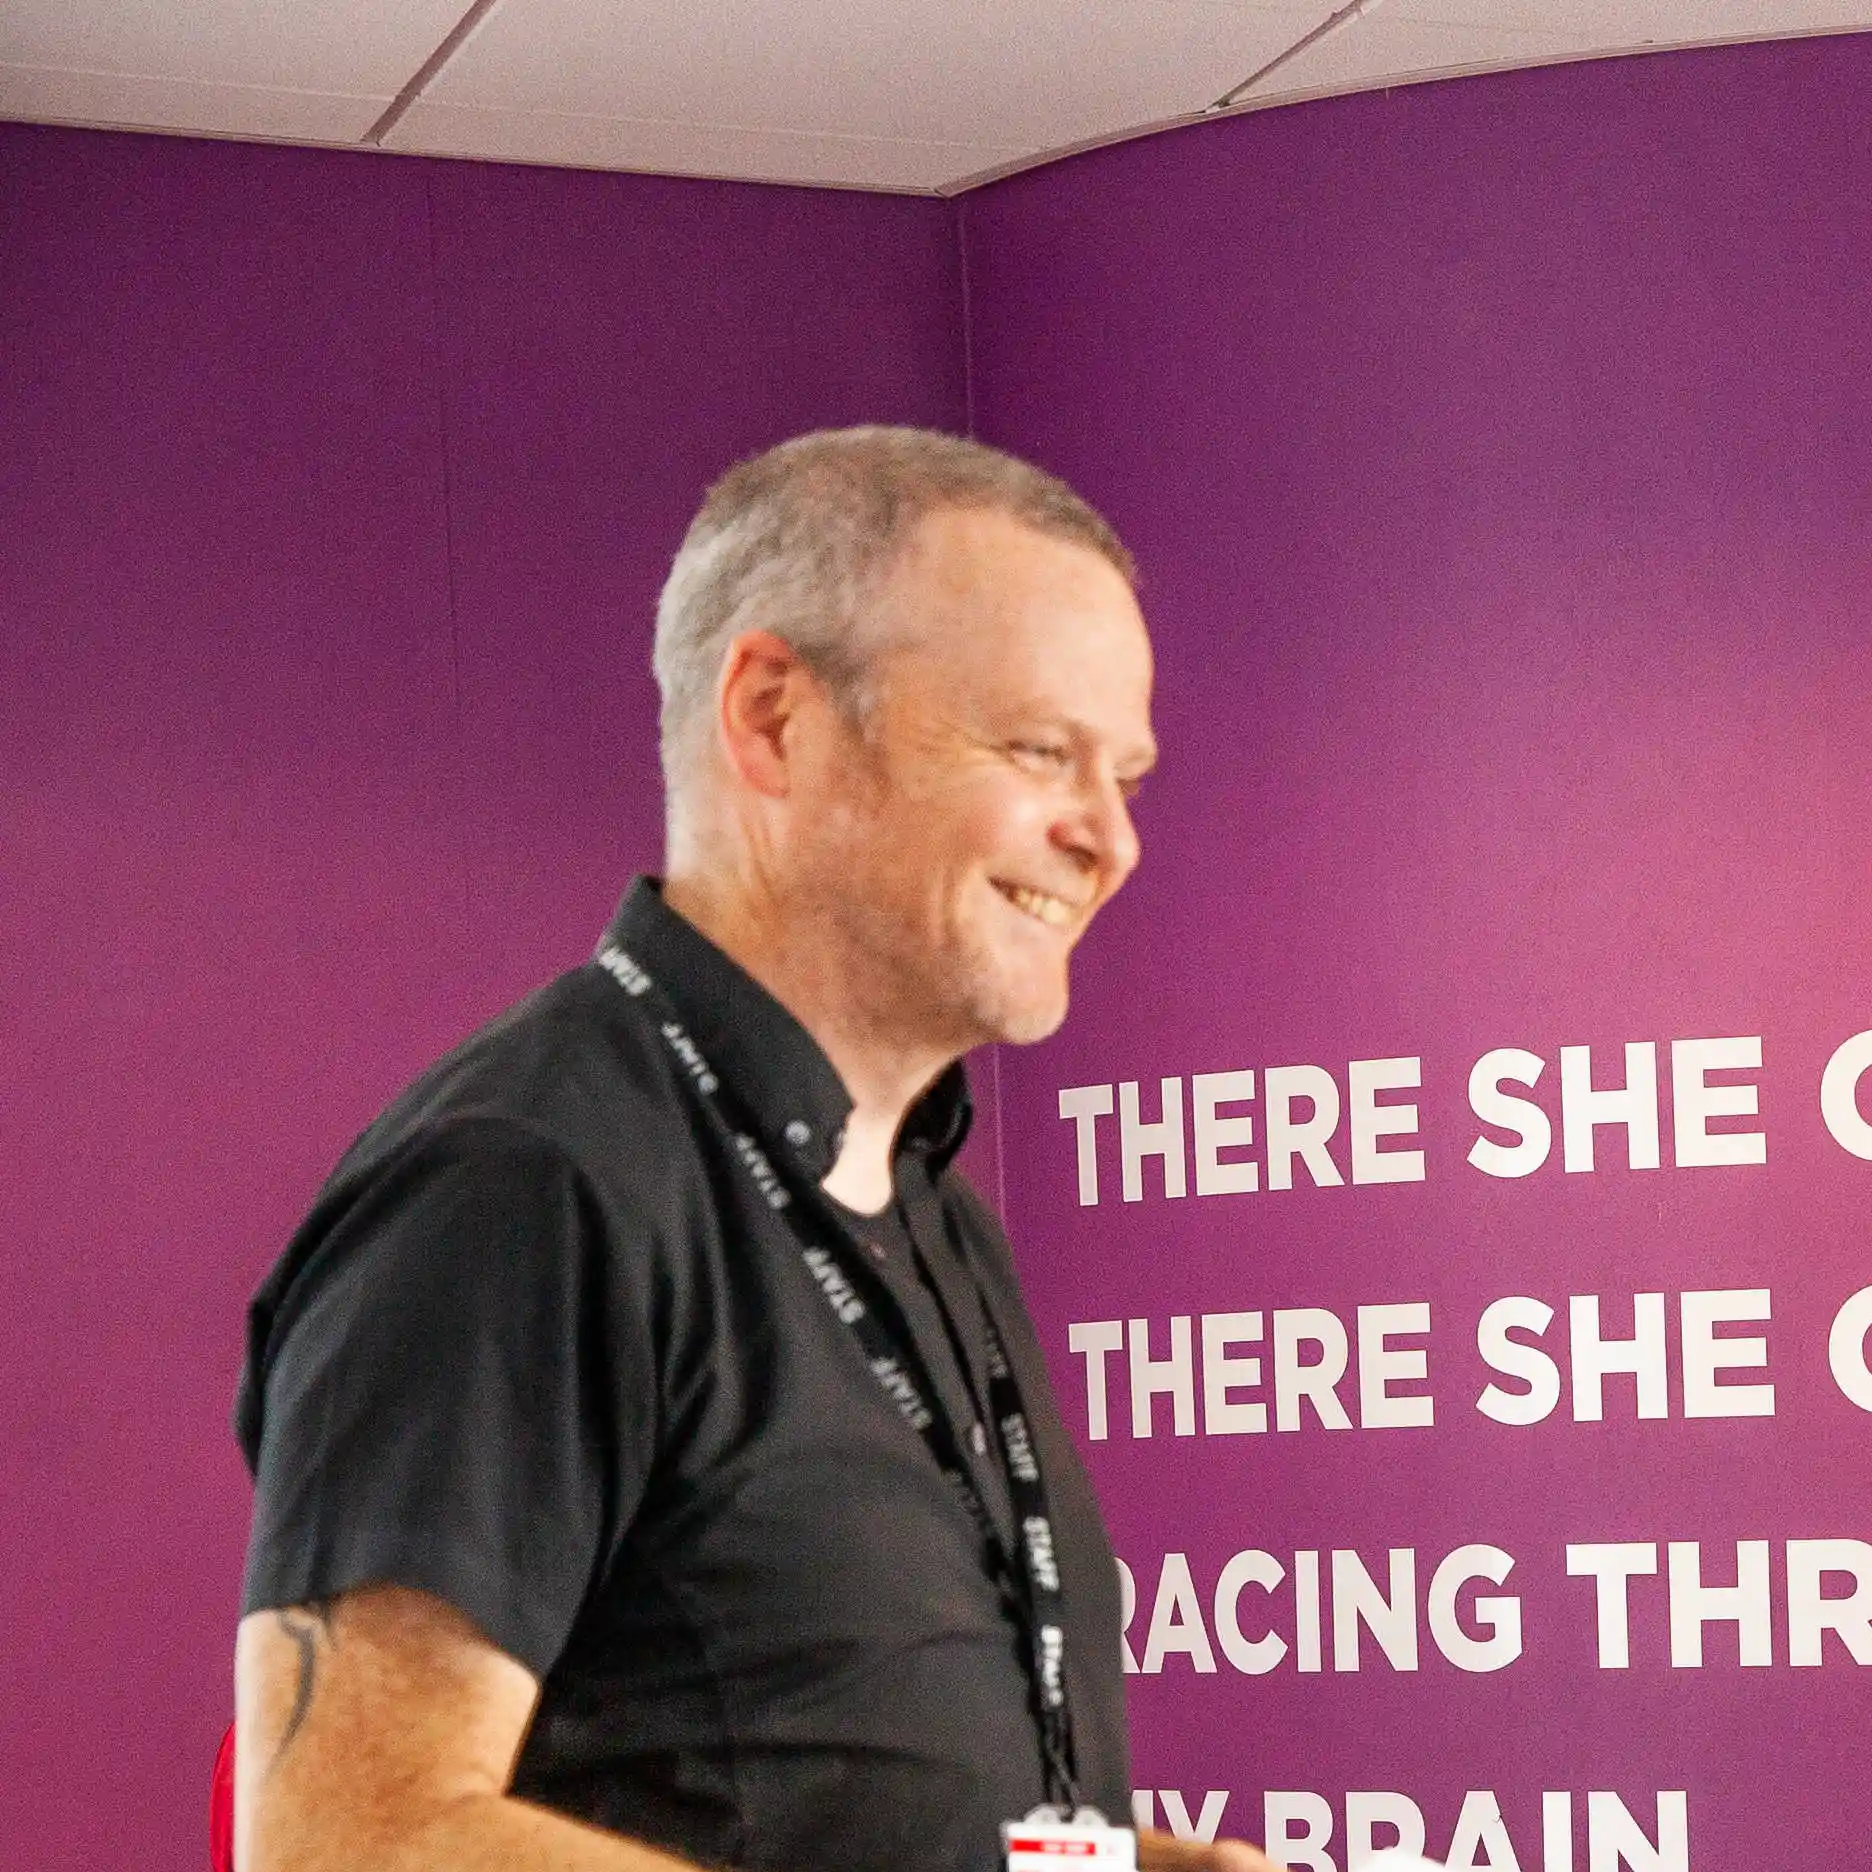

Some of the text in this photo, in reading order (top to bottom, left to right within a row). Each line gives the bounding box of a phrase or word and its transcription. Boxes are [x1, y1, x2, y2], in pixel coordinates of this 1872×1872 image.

[1057, 1055, 1427, 1207] THERE
[1465, 1034, 1768, 1179] SHE
[801, 1246, 867, 1324] STAFF
[1067, 1301, 1435, 1442] THERE
[1474, 1287, 1777, 1427] SHE
[1022, 1515, 1061, 1592] STAFF
